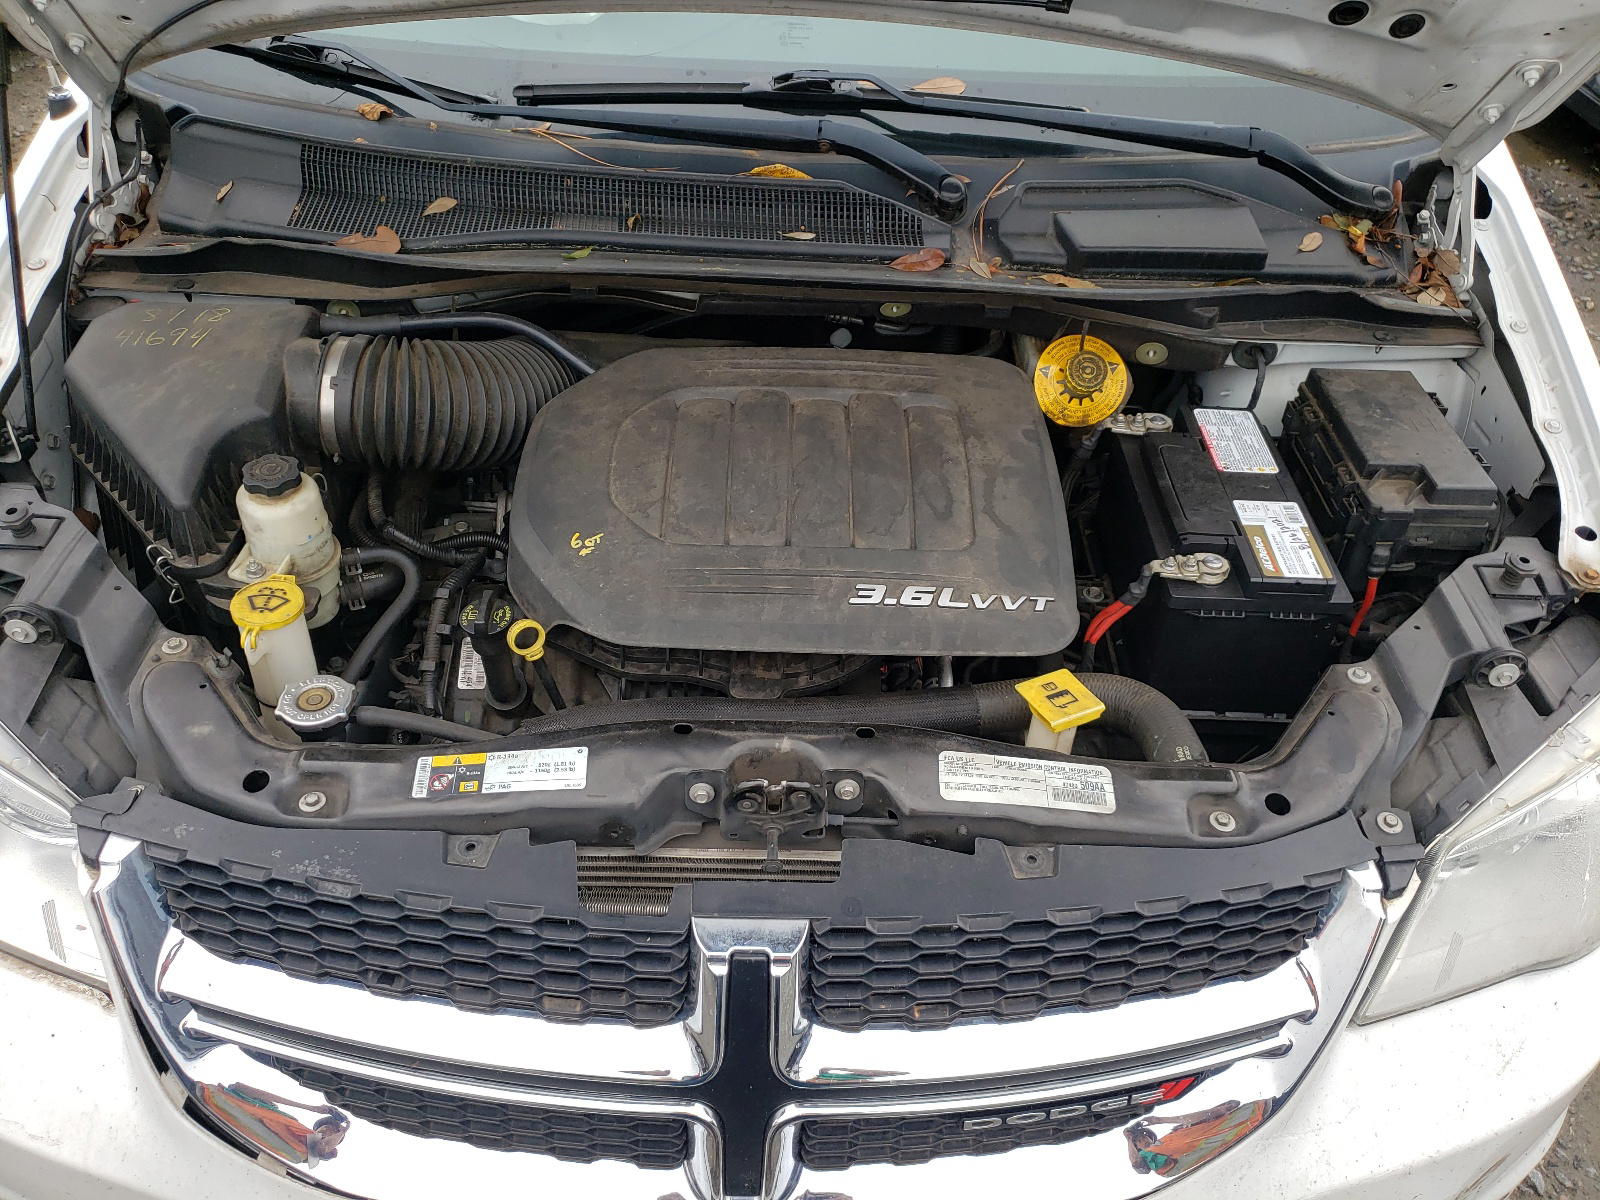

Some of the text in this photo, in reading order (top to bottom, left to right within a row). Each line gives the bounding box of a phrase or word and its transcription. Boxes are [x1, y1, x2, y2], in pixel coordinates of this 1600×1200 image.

[1252, 535, 1275, 571] ACDelco
[1018, 761, 1043, 770] EMISSION
[1044, 764, 1066, 772] CONTROL
[1068, 767, 1103, 775] INFORMATION
[1080, 781, 1105, 792] 509AA
[963, 1088, 1166, 1130] DODGE
